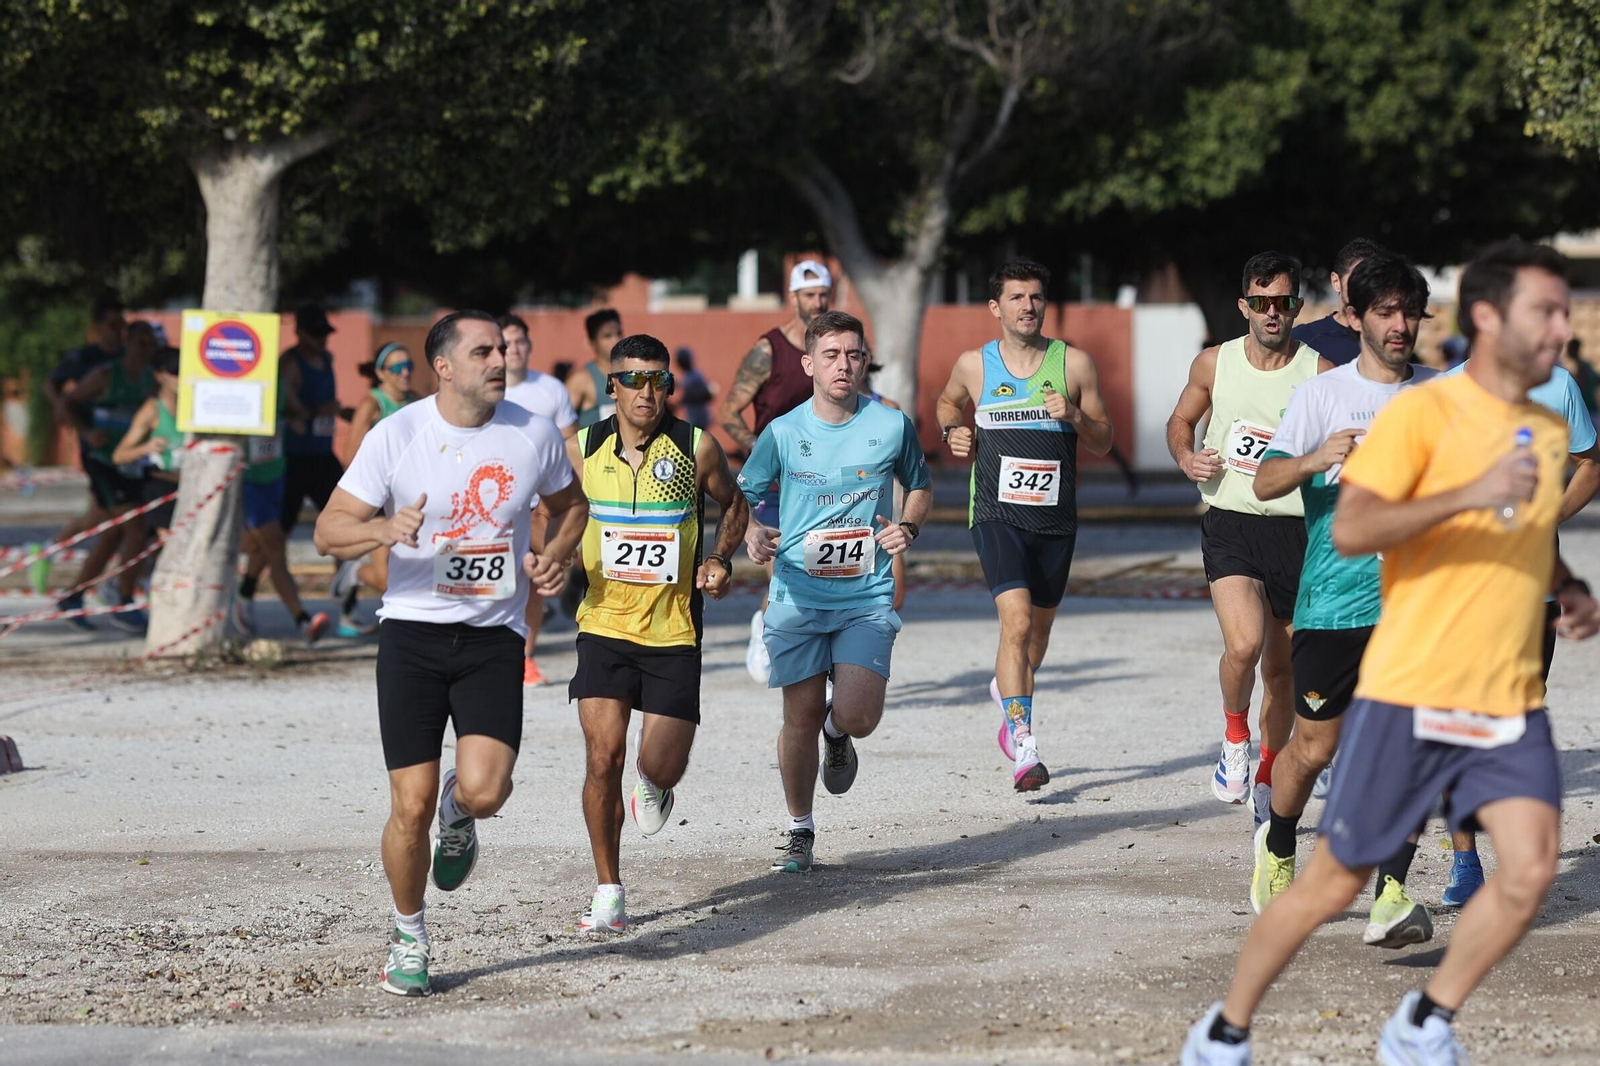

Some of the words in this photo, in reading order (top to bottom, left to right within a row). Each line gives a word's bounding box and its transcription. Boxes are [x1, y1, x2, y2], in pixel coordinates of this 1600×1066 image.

[1236, 435, 1269, 460] 37
[1009, 470, 1054, 492] 342
[817, 492, 834, 506] mi
[614, 542, 667, 567] 213
[816, 540, 864, 565] 214
[446, 555, 505, 581] 358
